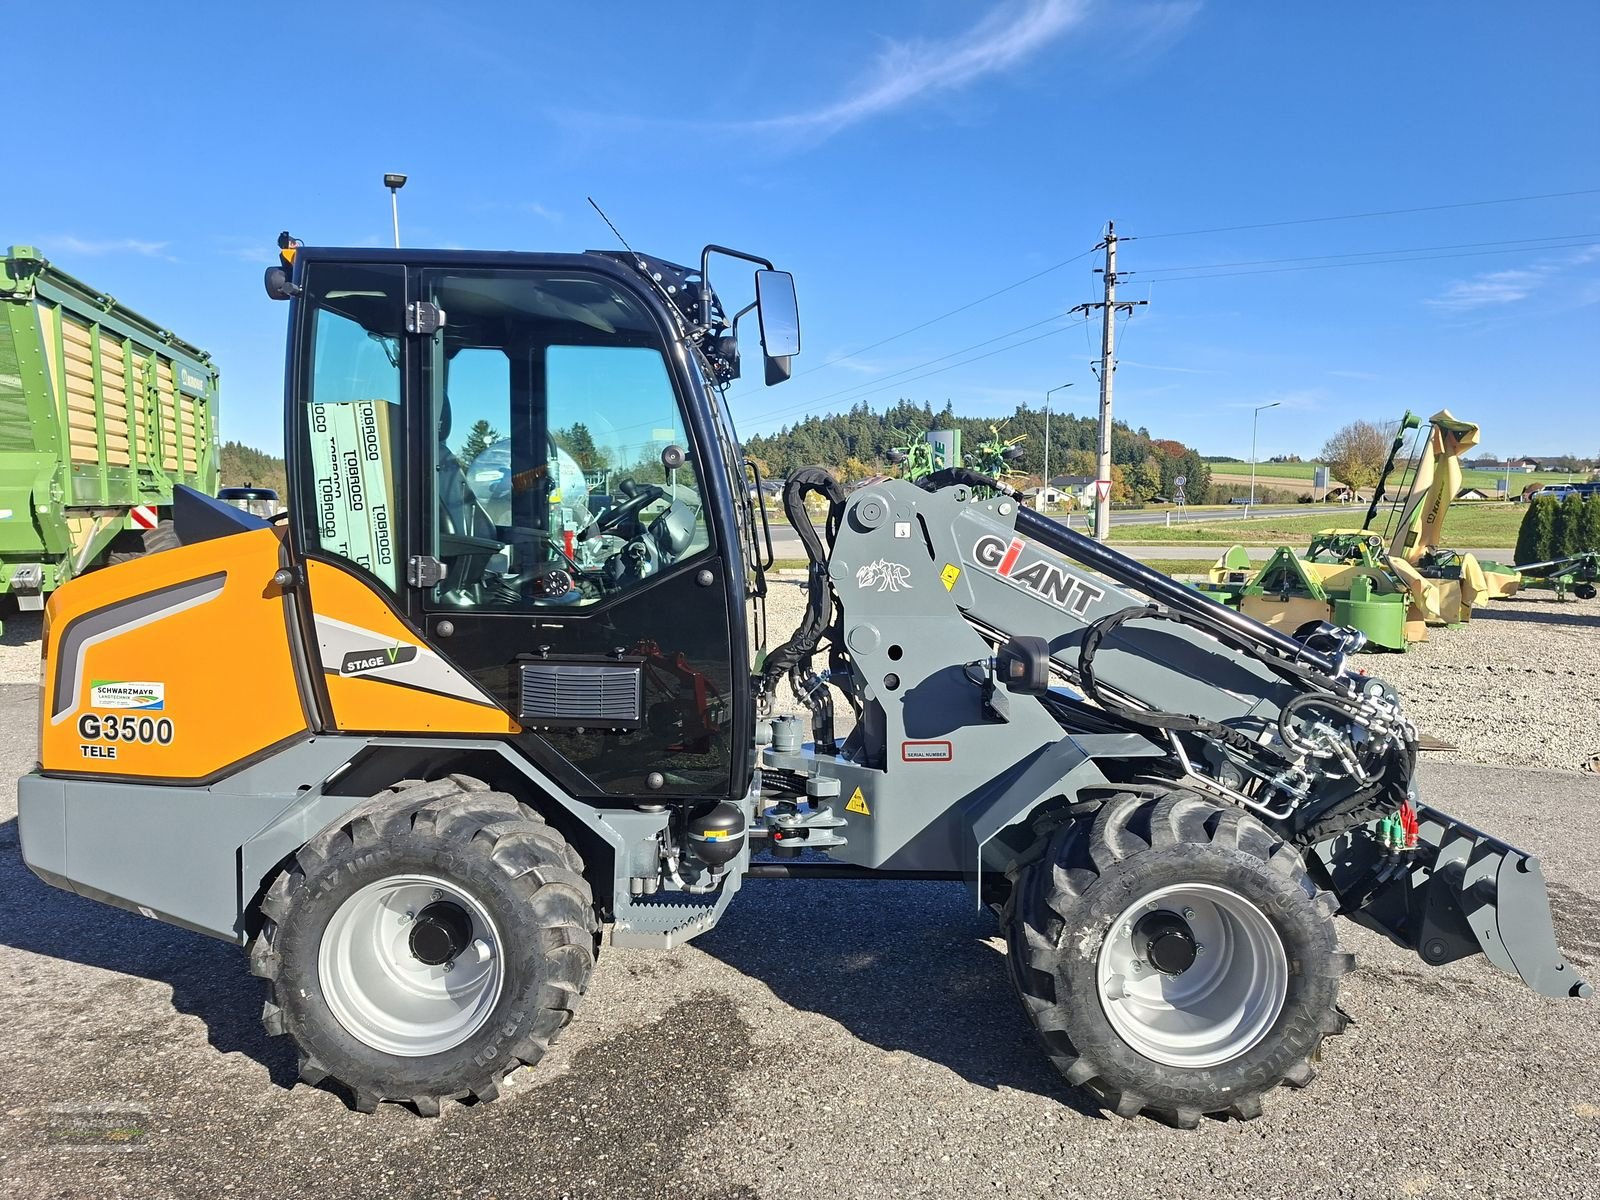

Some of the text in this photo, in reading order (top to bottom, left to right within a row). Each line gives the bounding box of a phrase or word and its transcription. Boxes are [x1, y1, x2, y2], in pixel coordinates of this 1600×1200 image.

[358, 401, 379, 461] TOBROCO
[343, 449, 364, 511] TOBROCO
[318, 476, 337, 538] TOBROCO
[372, 503, 392, 566] TOBROCO
[346, 640, 400, 671] STAGE V
[97, 687, 154, 695] SCHWARZMAYR
[78, 713, 174, 745] G3500
[80, 745, 117, 759] TELE
